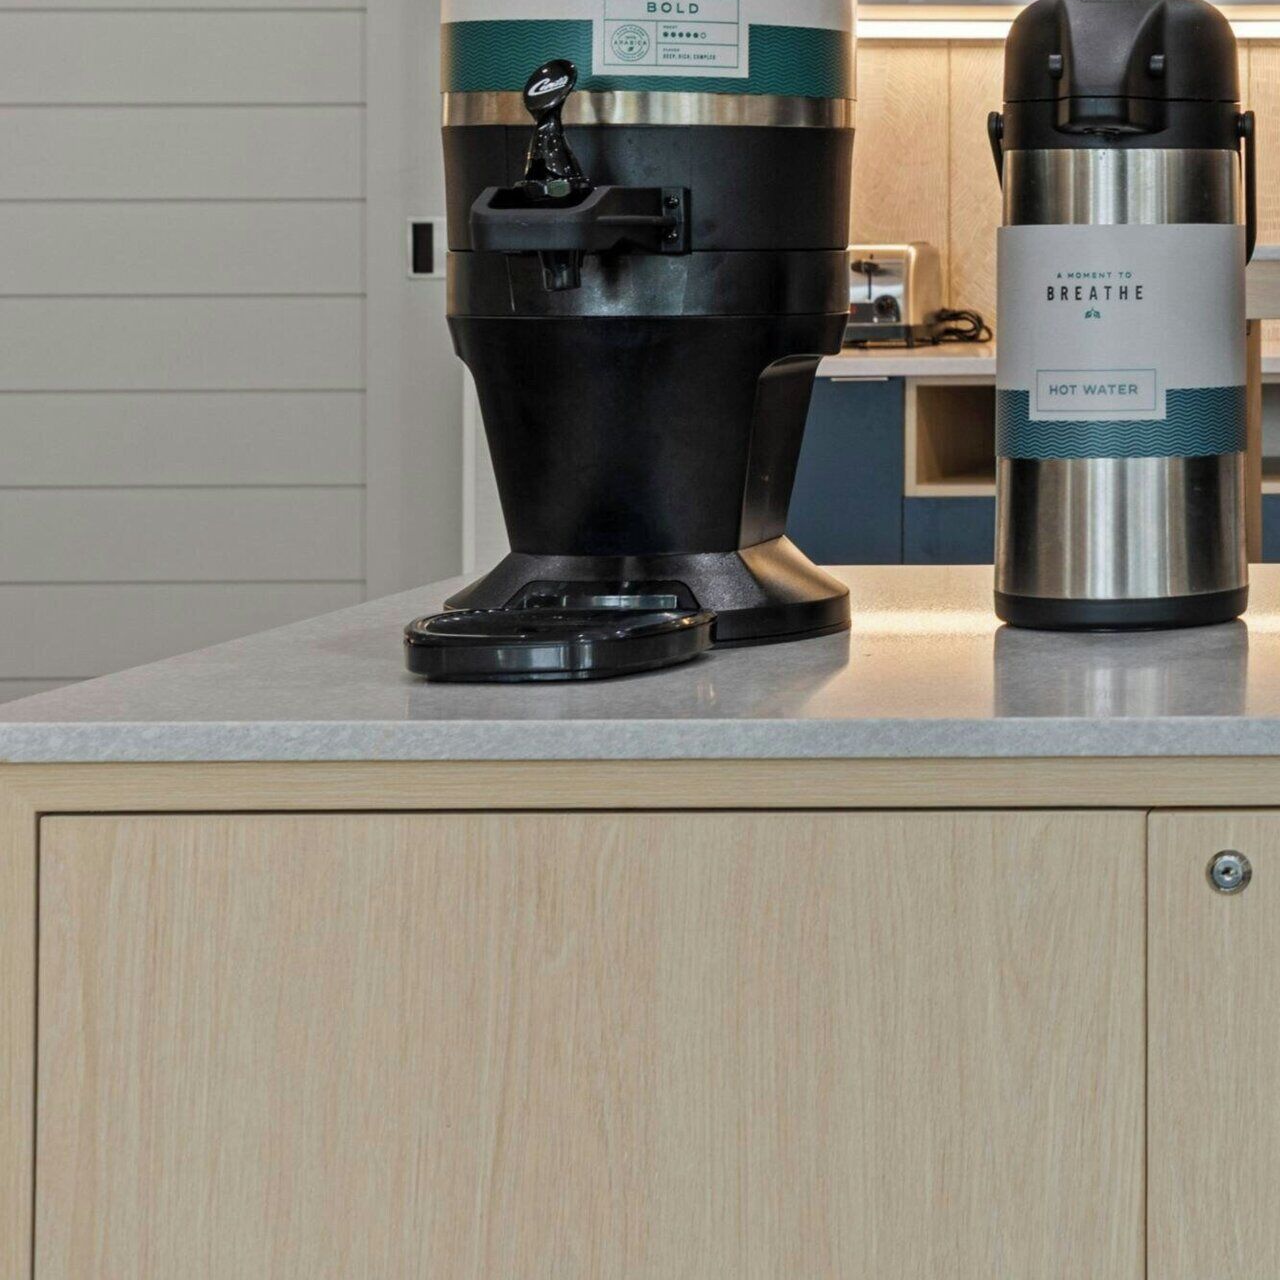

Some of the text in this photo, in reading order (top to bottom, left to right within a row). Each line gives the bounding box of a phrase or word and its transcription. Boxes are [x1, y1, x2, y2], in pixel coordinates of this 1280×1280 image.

[646, 1, 699, 14] BOLD
[1047, 285, 1144, 301] BREATHE
[1049, 384, 1138, 395] HOT WATER
